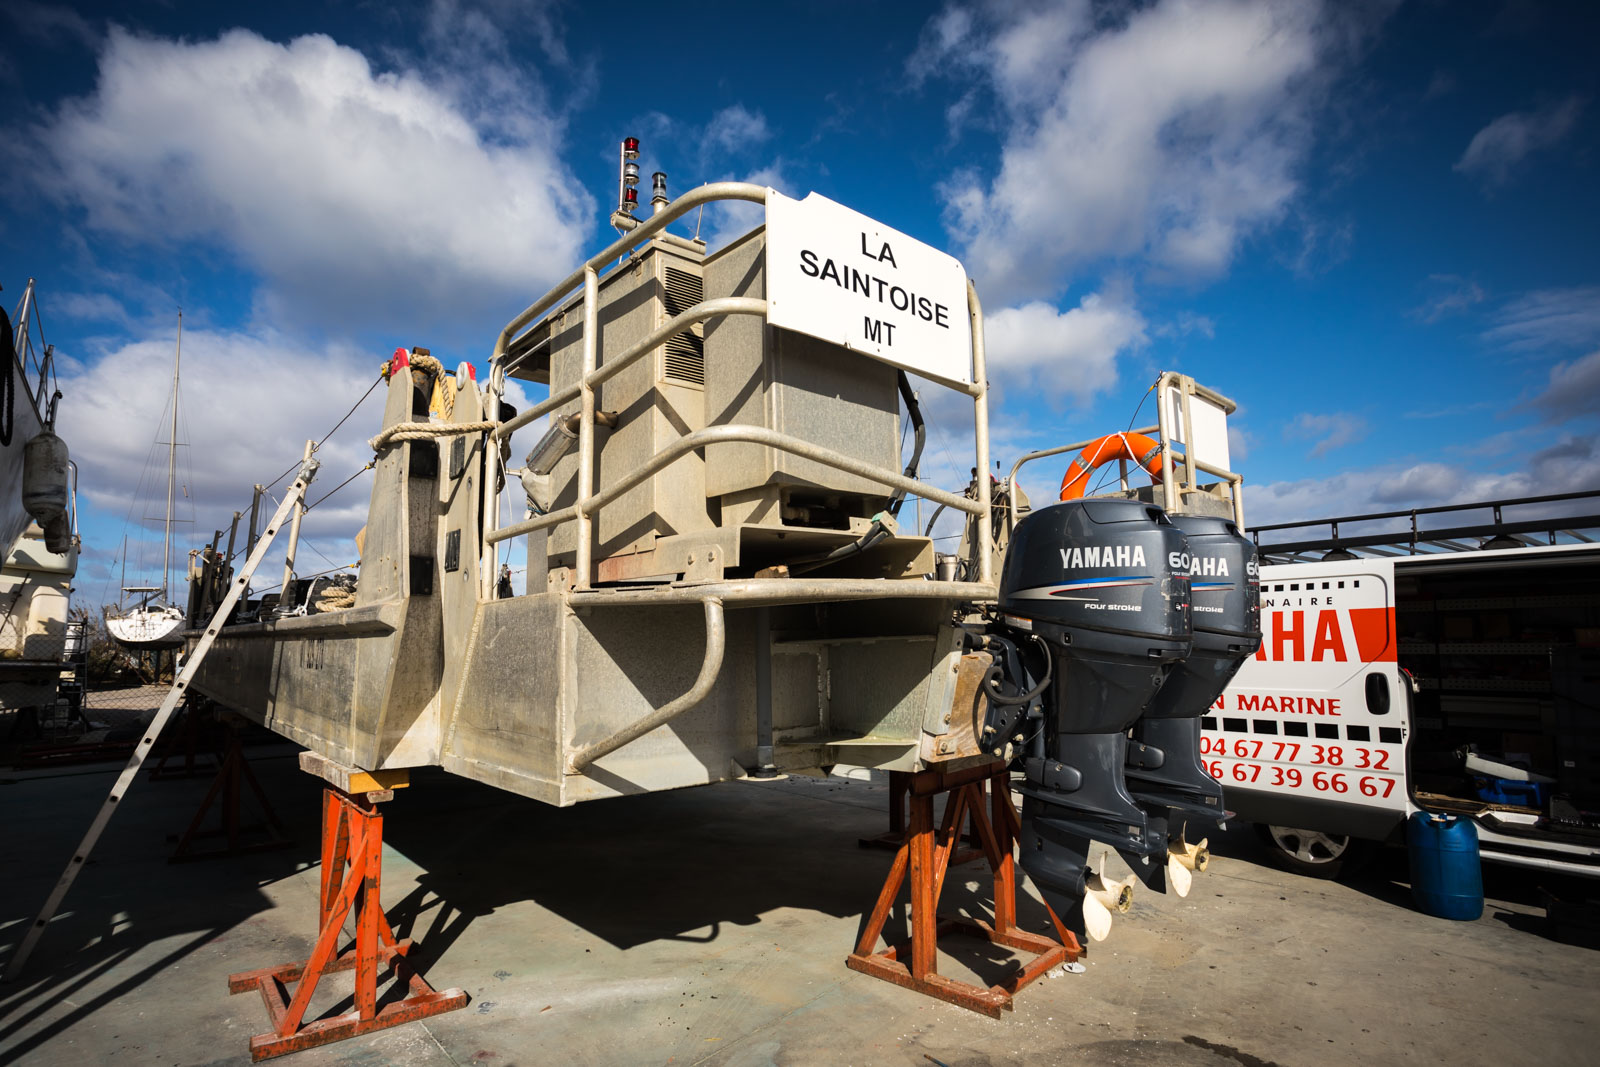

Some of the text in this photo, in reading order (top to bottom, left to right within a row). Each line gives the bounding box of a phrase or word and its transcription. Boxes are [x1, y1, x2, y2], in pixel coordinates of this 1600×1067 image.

[861, 232, 897, 269] LA
[800, 250, 949, 329] SAINTOISE
[864, 316, 896, 346] MT
[1060, 545, 1146, 569] YAMAHA
[1168, 551, 1189, 569] 60
[1237, 694, 1341, 716] MARINE
[1200, 736, 1390, 770] 04 67 77 38 32
[1232, 763, 1261, 783] 67
[1270, 766, 1302, 788] 39
[1312, 771, 1348, 793] 66
[1359, 776, 1396, 798] 67
